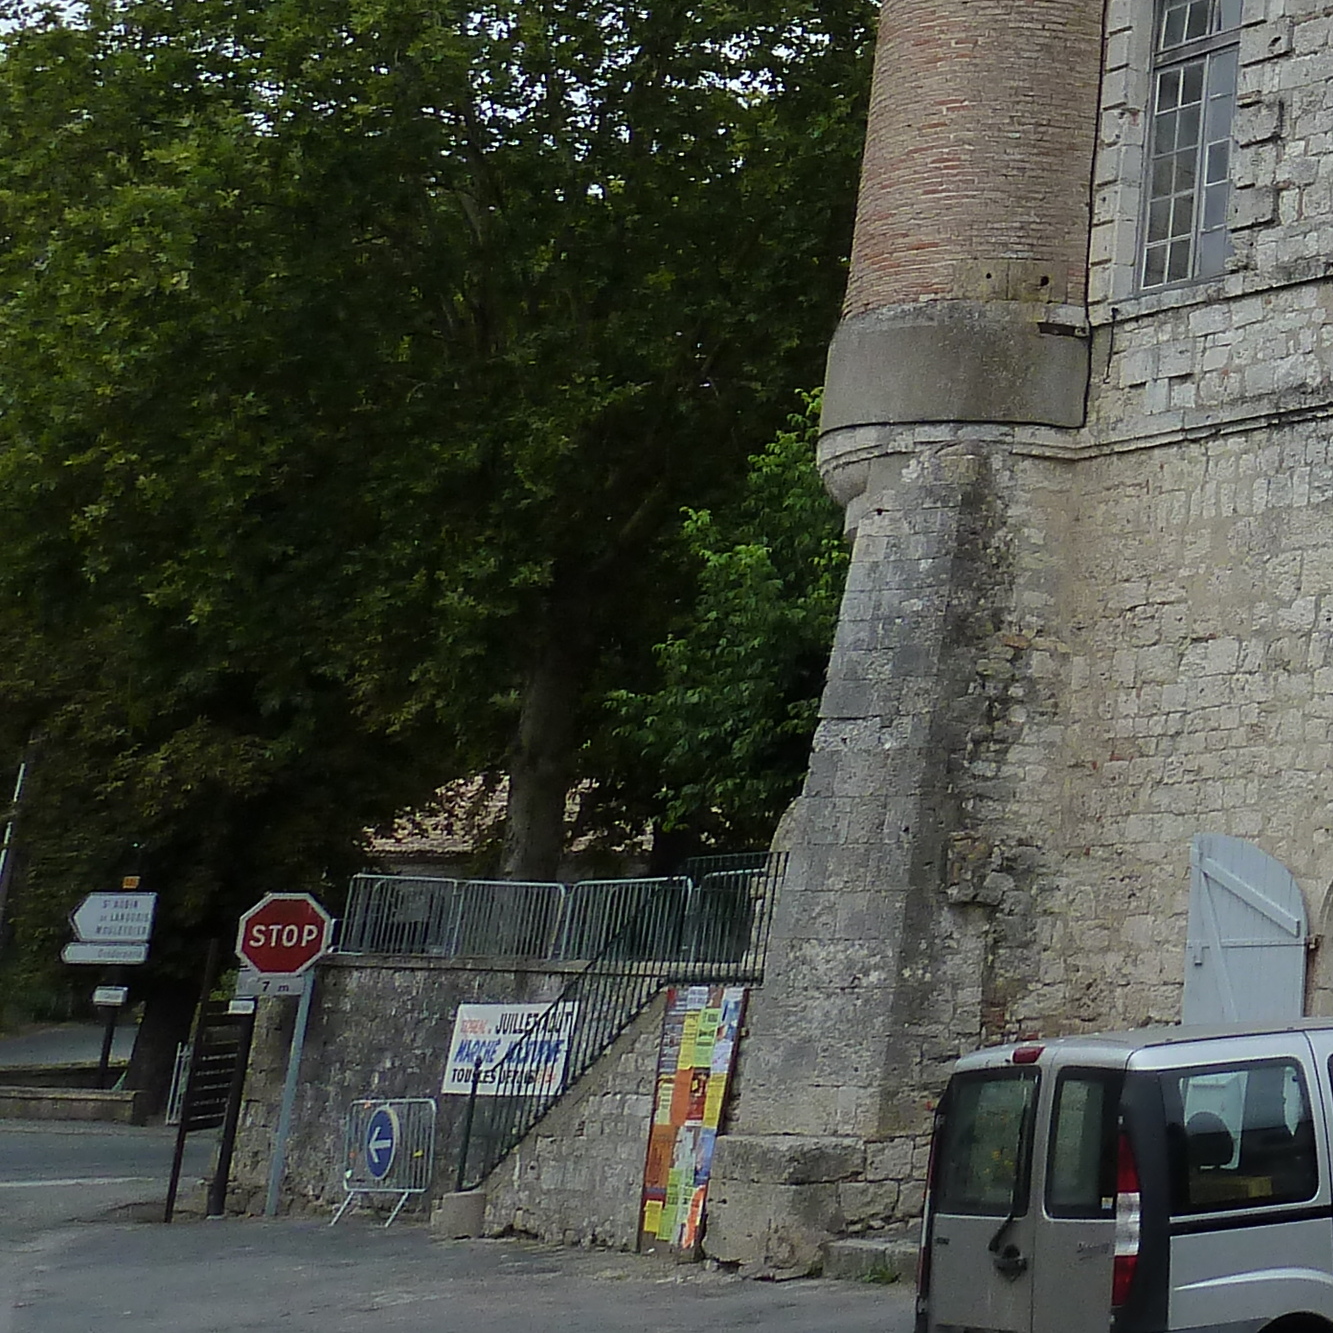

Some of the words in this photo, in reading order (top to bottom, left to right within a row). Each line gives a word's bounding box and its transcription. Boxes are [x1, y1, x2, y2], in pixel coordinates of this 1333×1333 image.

[249, 925, 318, 948] STOP
[262, 982, 270, 992] 7
[278, 984, 290, 992] m
[495, 1012, 541, 1035] JUILLET
[452, 1068, 479, 1083] TOU
